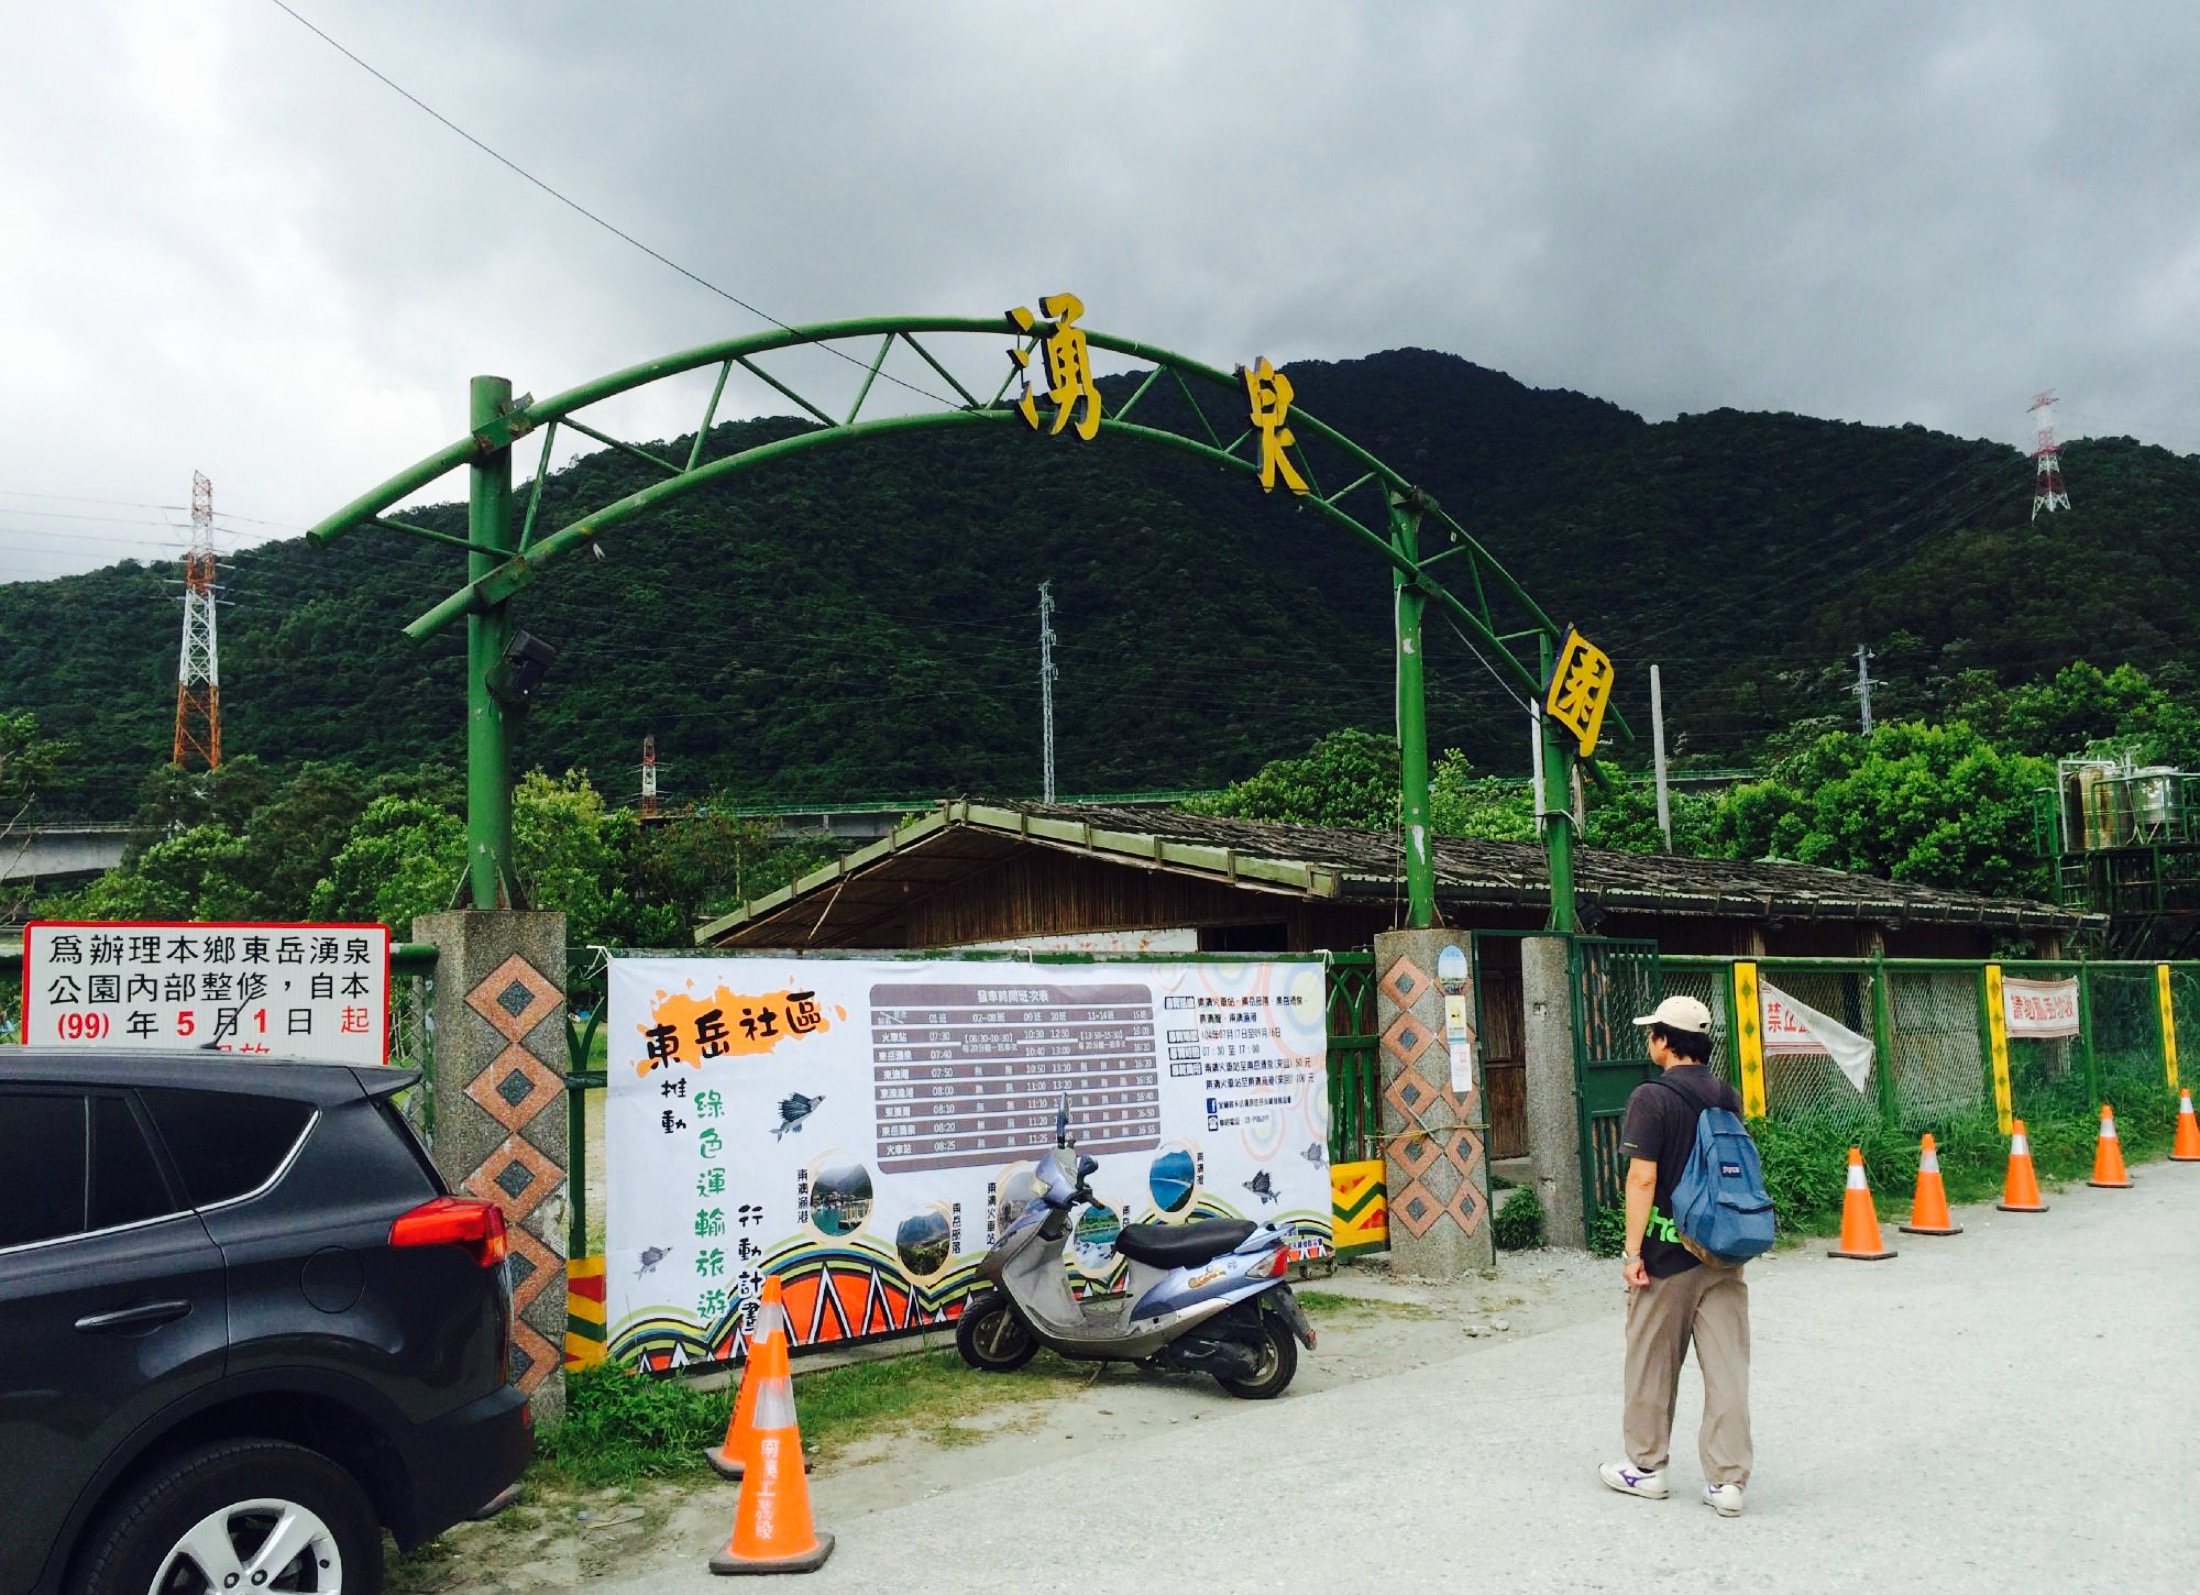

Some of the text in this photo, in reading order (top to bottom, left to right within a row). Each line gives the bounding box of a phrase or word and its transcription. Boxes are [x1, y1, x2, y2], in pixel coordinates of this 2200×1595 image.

[1004, 292, 1615, 758] 湧 泉 園
[645, 990, 821, 1070] 東岳社區
[660, 1077, 687, 1134] 推動
[693, 1089, 726, 1319] 綠色運輸旅遊
